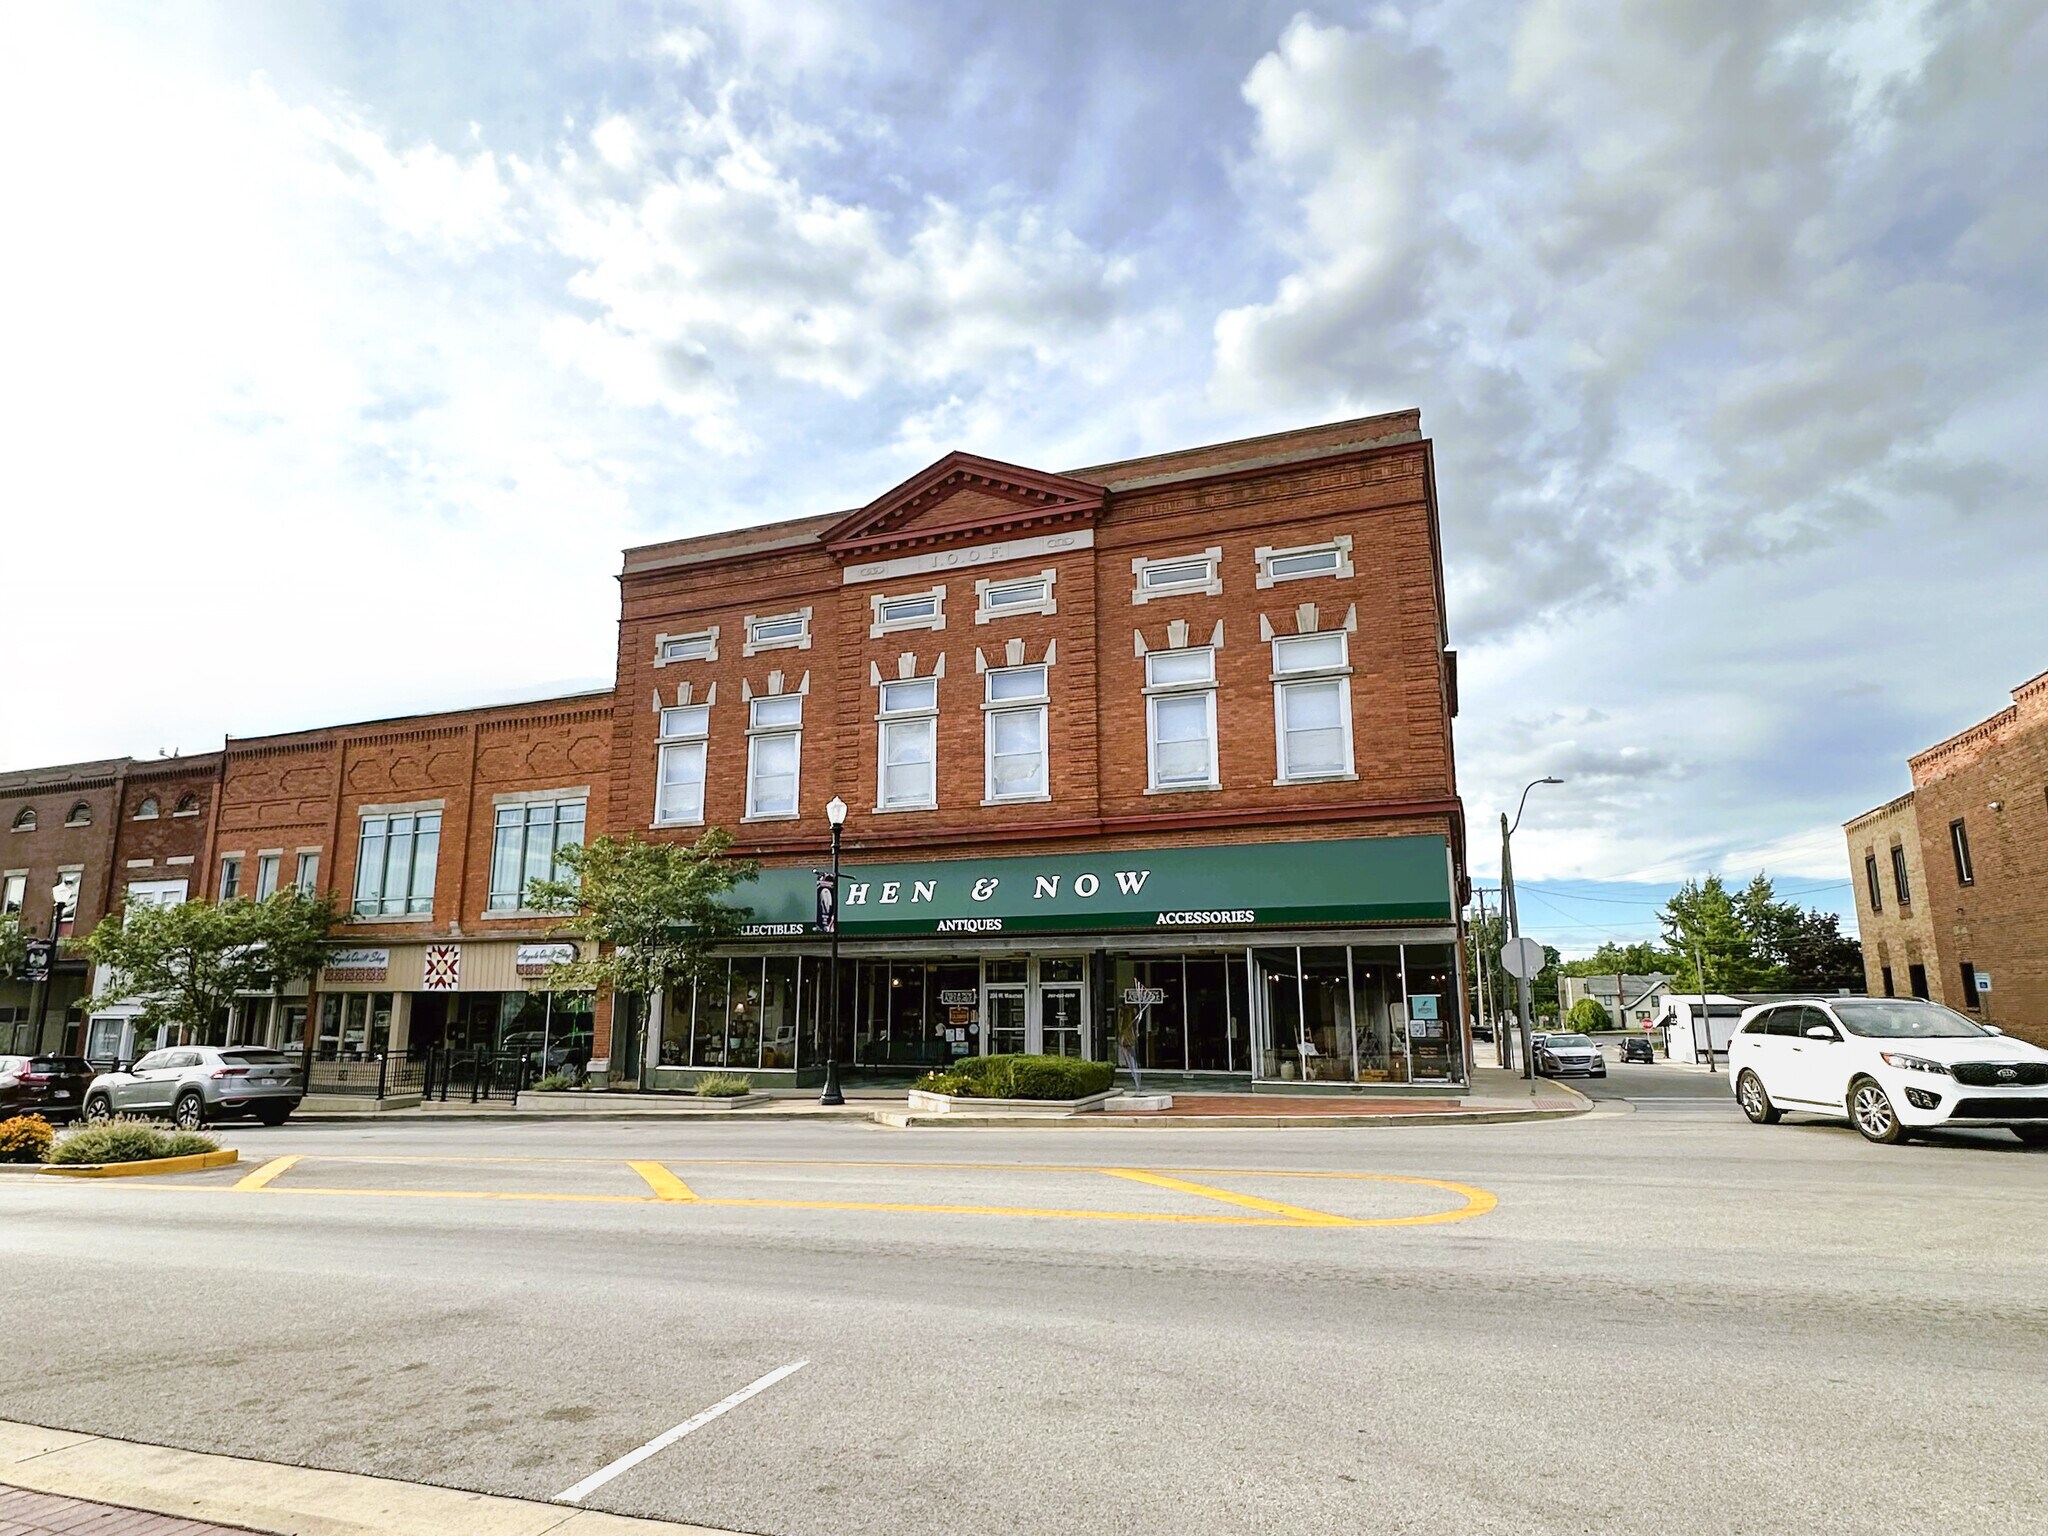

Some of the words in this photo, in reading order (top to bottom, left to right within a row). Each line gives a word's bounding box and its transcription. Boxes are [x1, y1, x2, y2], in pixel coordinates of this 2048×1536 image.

[845, 880, 937, 905] HEN
[970, 878, 1000, 902] &
[1033, 870, 1151, 899] NOW
[1156, 911, 1255, 925] ACCESSORIES
[735, 924, 804, 936] LLECTIBLES
[936, 919, 1003, 933] ANTIQUES
